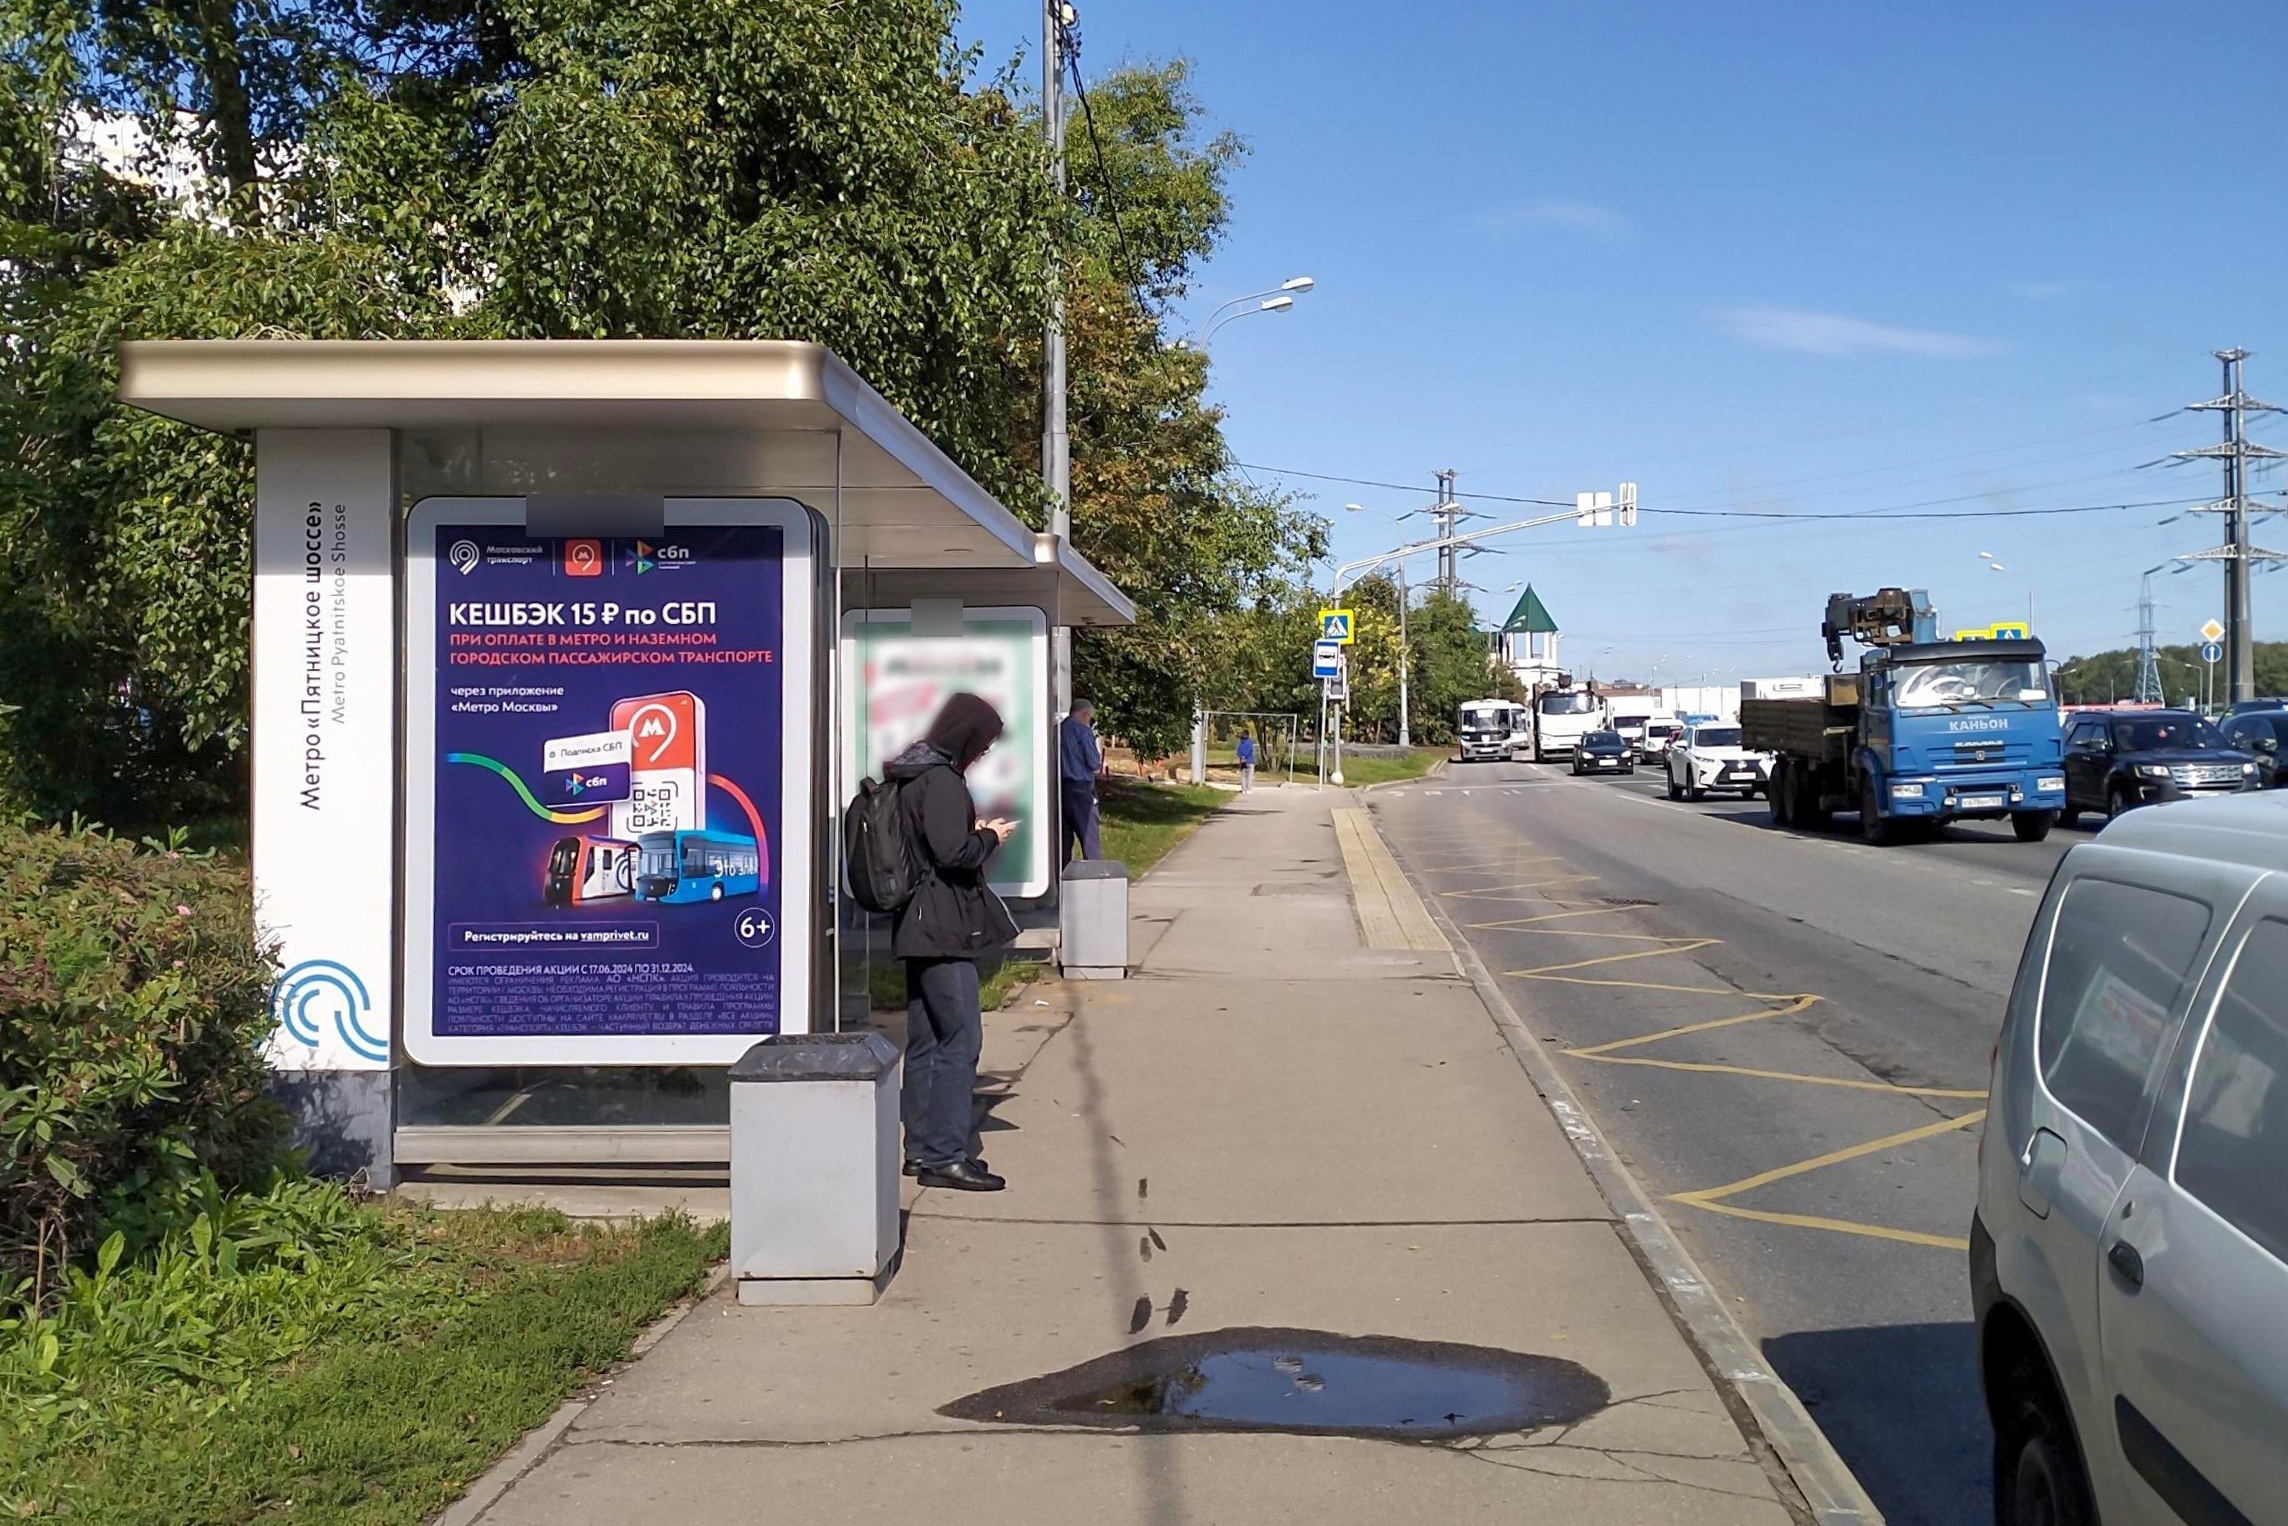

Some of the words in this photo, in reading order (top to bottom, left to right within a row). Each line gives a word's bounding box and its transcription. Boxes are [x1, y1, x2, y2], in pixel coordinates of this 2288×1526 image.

[331, 504, 346, 562] Shosse
[306, 502, 322, 583] шоссе»
[657, 545, 690, 559] сбп
[330, 568, 348, 666] Pyatnitskoe
[450, 602, 565, 625] КЕШБЭК
[570, 602, 596, 625] 15
[601, 602, 619, 625] ₽
[625, 609, 657, 625] по
[662, 602, 716, 625] СБП
[450, 633, 482, 646] ПРИ
[484, 633, 545, 646] ОПЛАТЕ
[547, 633, 557, 646] В
[559, 633, 611, 646] МЕТРО
[614, 633, 626, 645] И
[628, 632, 717, 645] НАЗЕМНОМ
[301, 591, 324, 729] «Пятницкое
[450, 652, 546, 666] ГОРОДСКОМ
[549, 651, 675, 665] ПАССАЖИРСКОМ
[678, 650, 773, 663] ТРАНСПОРТЕ
[331, 671, 346, 724] Metro
[450, 687, 486, 698] через
[488, 686, 564, 698] приложение
[451, 701, 500, 714] «Метро
[502, 701, 558, 713] Москвы»
[1949, 718, 2009, 731] КАНЬОН
[602, 741, 623, 752] СБП
[300, 734, 325, 810] Метро
[585, 776, 608, 788] сбп
[740, 916, 770, 939] 6+
[464, 931, 563, 944] Регистрируйтесь
[565, 932, 579, 941] на
[580, 929, 650, 942] vamprivet.ru
[448, 966, 475, 976] СРОК
[476, 965, 542, 976] ПРОВЕДЕНИЯ
[543, 965, 580, 976] АКЦИИ
[634, 964, 650, 973] ПО
